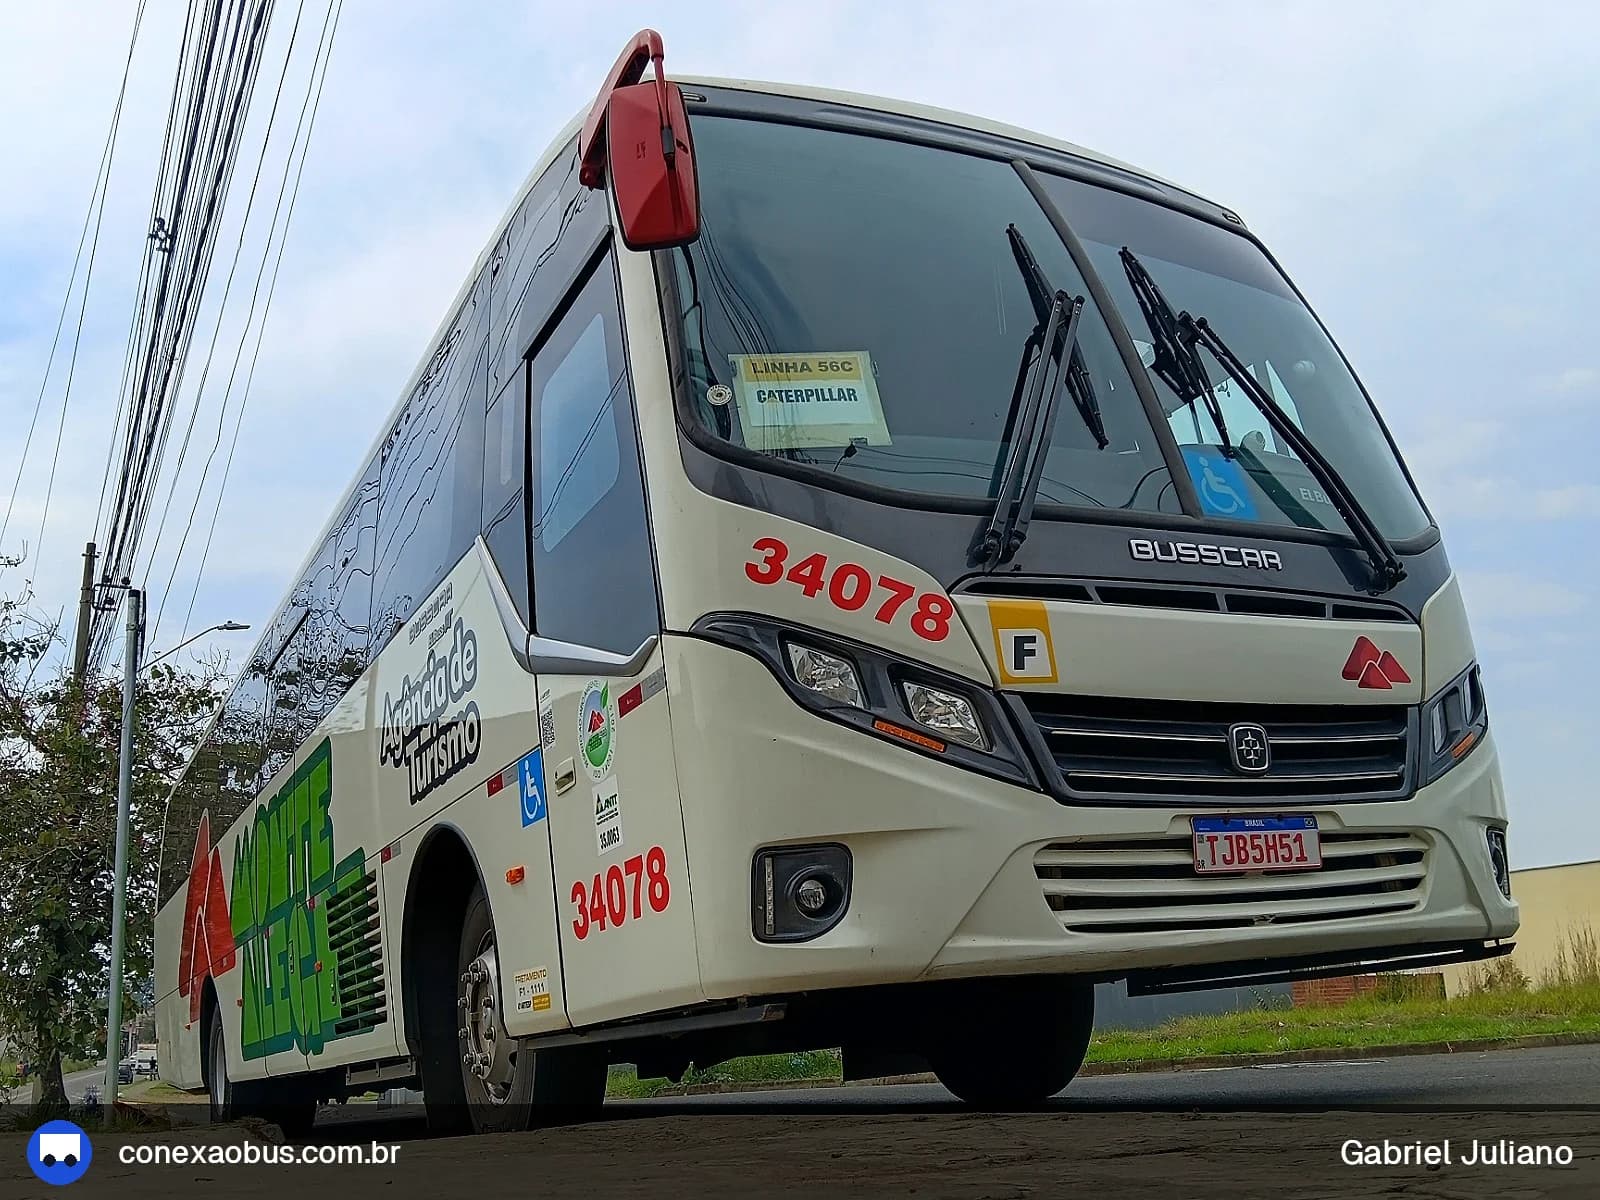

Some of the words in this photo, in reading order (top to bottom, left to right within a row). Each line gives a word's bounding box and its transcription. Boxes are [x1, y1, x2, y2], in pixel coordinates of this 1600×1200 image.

[752, 362, 813, 374] LINHA
[818, 361, 853, 373] 56C
[757, 387, 858, 403] CATERPILLAR
[1128, 539, 1283, 571] BUSSCAR
[744, 537, 954, 642] 34078
[1013, 635, 1037, 671] F
[380, 648, 448, 768] Agência
[449, 616, 478, 703] de
[405, 700, 482, 806] Turismo
[1206, 833, 1308, 866] TJB5H51
[570, 846, 670, 941] 34078
